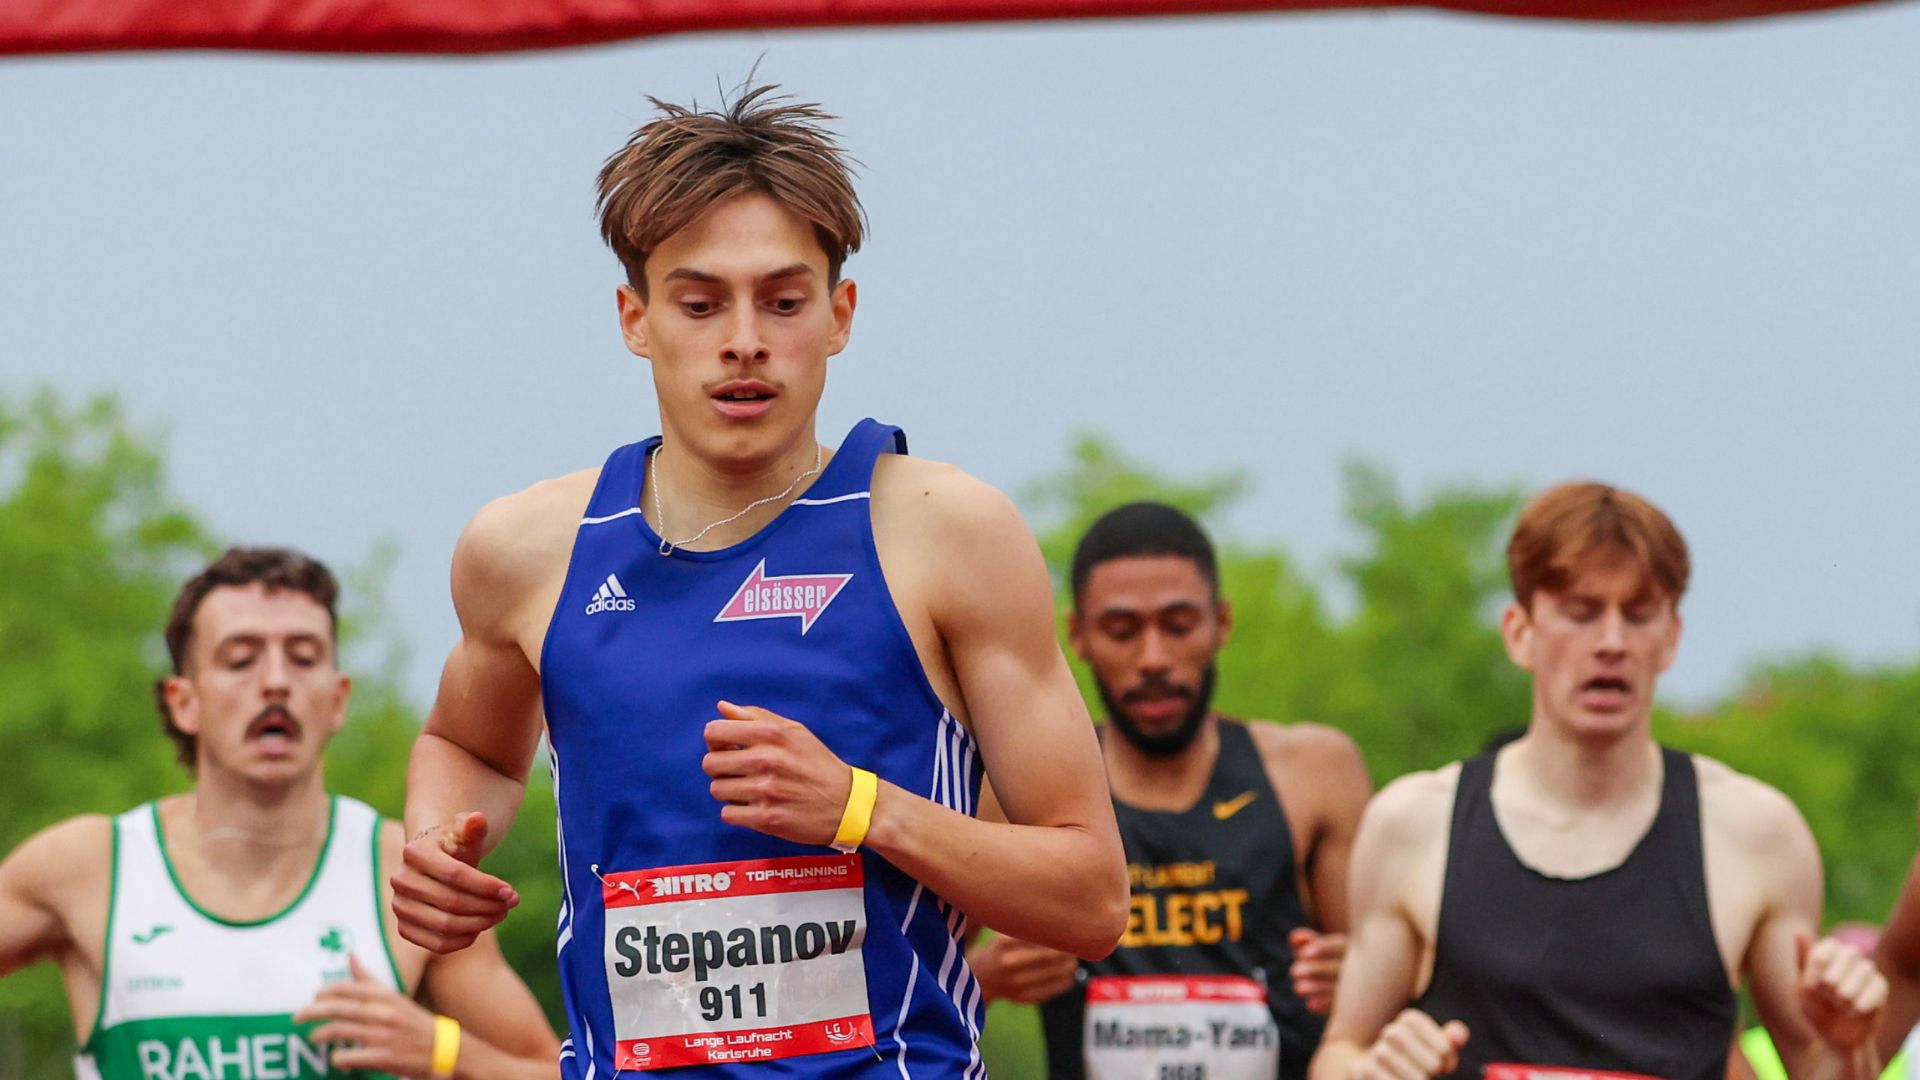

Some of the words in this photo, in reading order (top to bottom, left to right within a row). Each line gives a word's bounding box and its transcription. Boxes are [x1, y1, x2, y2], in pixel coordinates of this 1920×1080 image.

[585, 596, 636, 615] adidas
[743, 583, 826, 613] elsässer
[646, 873, 731, 897] NITRO
[746, 865, 848, 882] TOP4RUNNING
[1118, 888, 1249, 948] ELECT
[614, 919, 856, 981] Stepanov
[699, 982, 767, 1022] 911
[685, 1035, 724, 1048] Lange
[727, 1030, 793, 1045] Laufnacht
[708, 1047, 772, 1061] Karlsruhe
[137, 1031, 362, 1080] RAHEN
